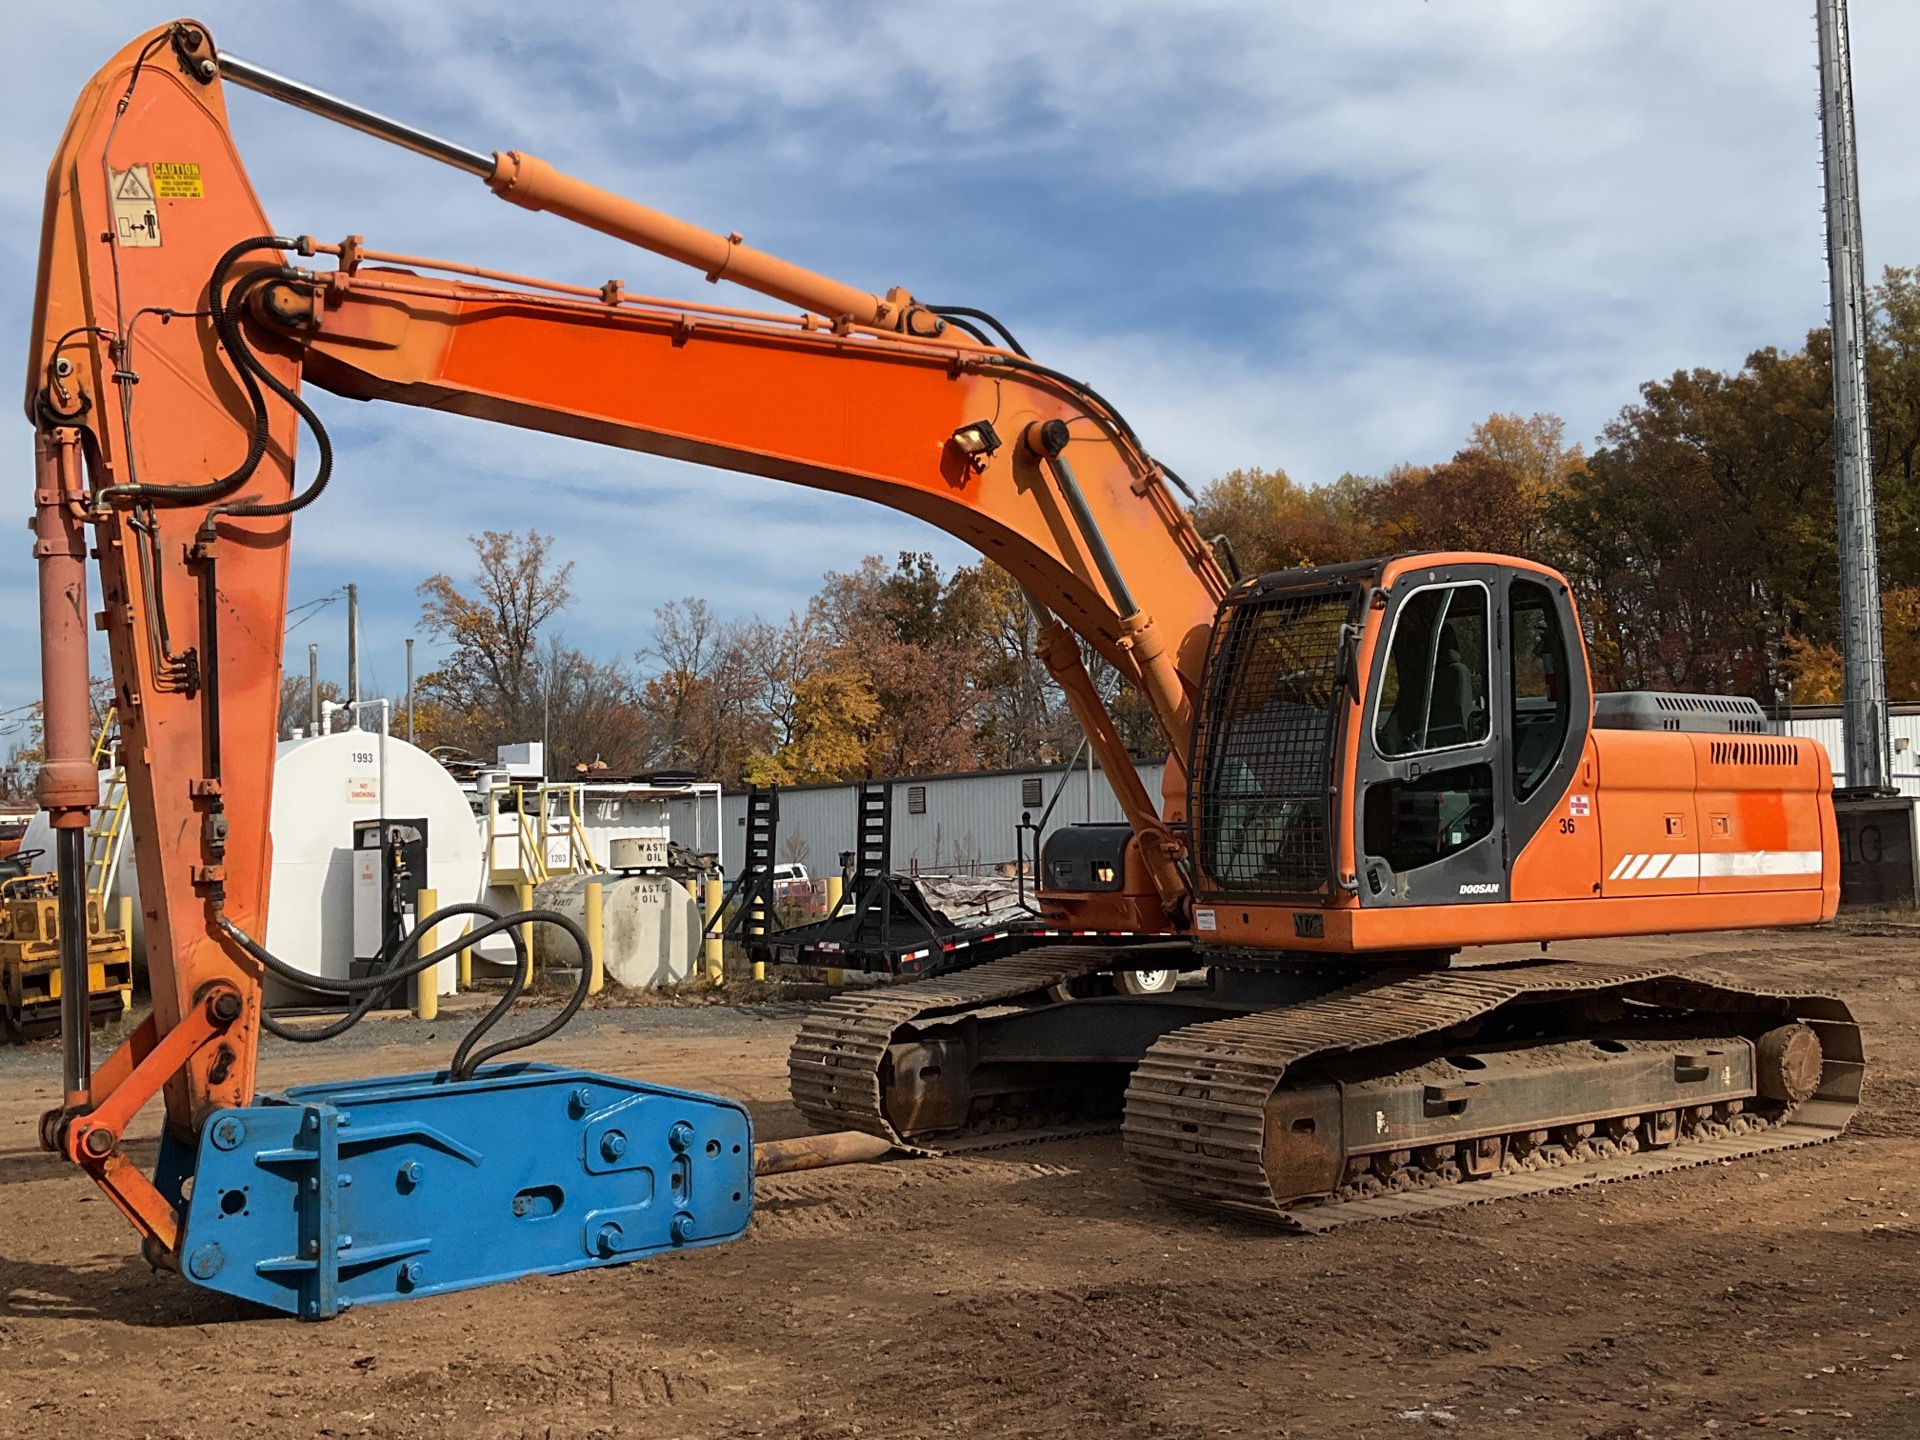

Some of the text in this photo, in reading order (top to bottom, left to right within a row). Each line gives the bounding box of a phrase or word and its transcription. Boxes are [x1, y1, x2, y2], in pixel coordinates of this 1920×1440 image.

[153, 163, 199, 174] CAUTION
[352, 752, 373, 764] 1993
[1559, 818, 1575, 834] 36
[638, 843, 666, 852] WASTE
[550, 854, 567, 863] 1203
[647, 853, 662, 862] OIL
[634, 884, 667, 893] WASTE
[1459, 884, 1500, 894] DOOSAN
[642, 895, 658, 903] OIL
